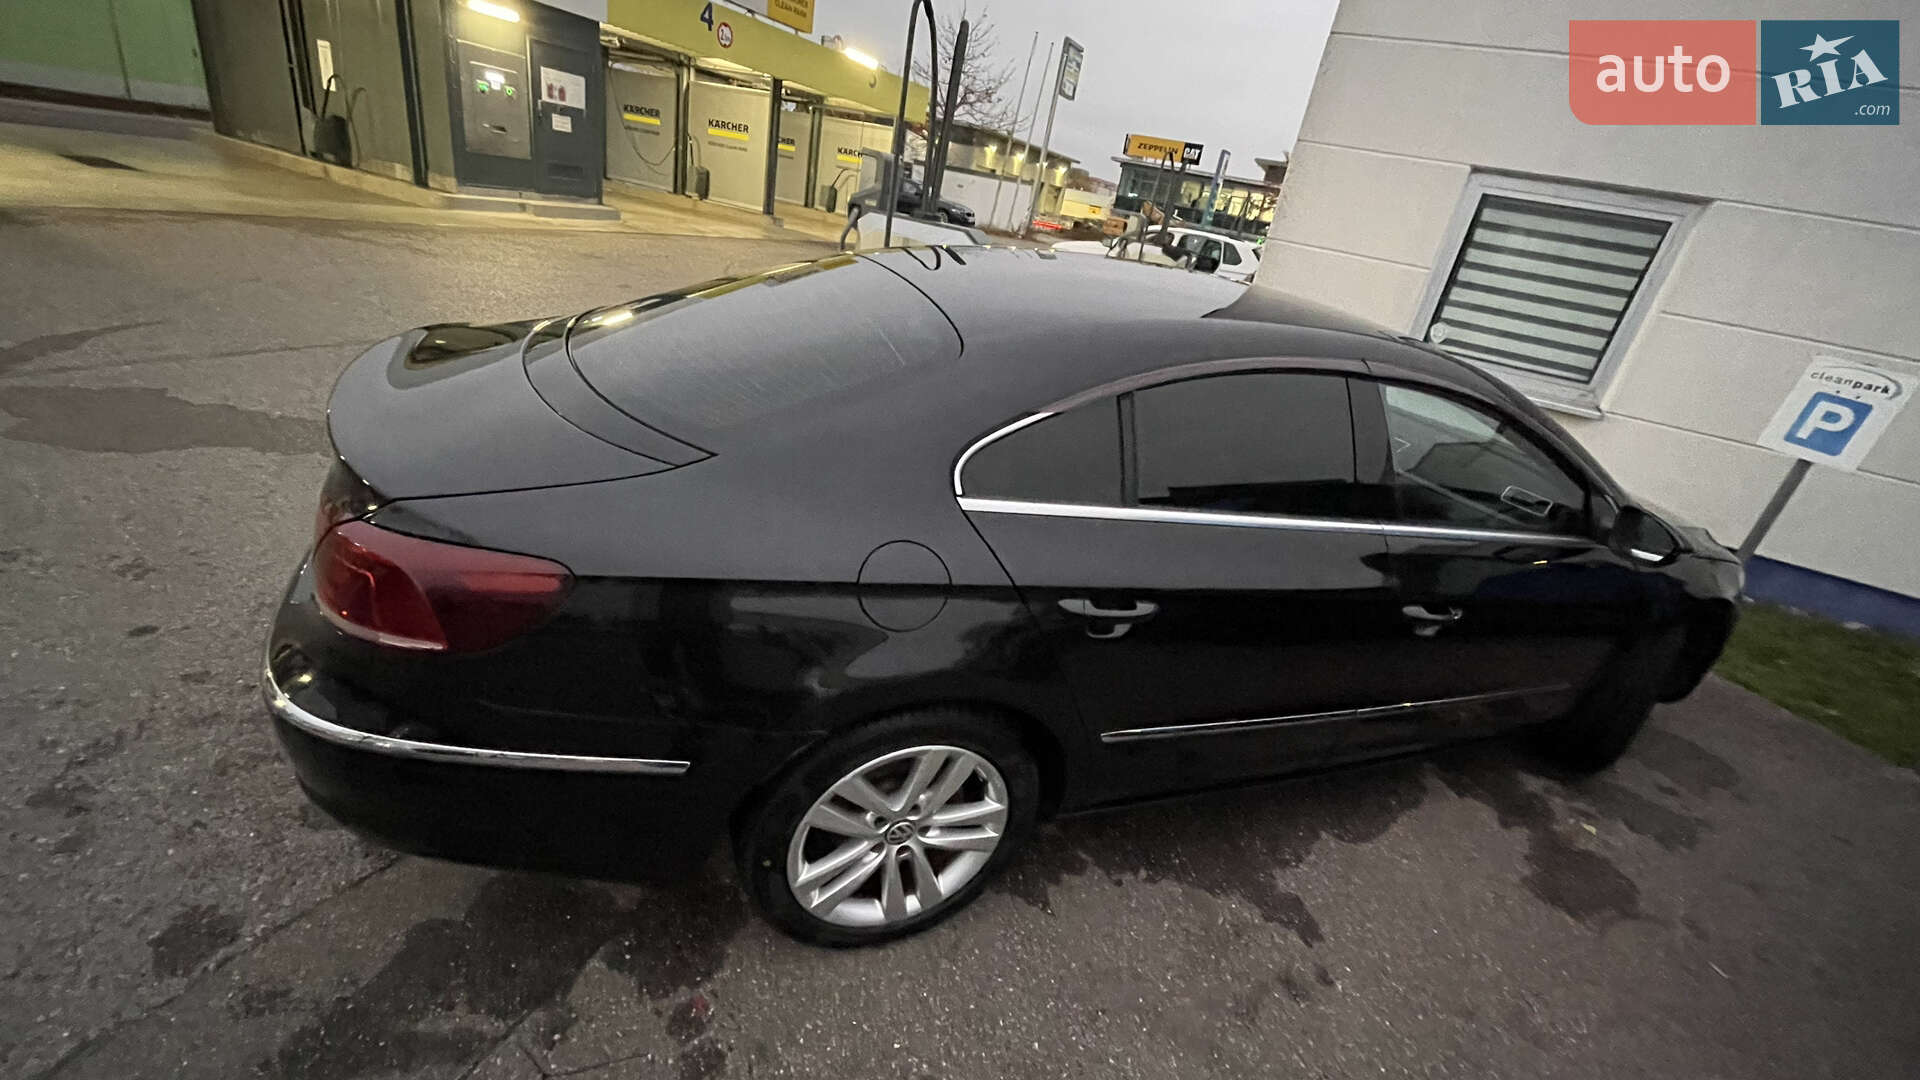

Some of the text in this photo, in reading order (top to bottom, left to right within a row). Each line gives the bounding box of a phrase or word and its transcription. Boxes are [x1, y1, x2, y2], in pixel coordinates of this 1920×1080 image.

[700, 2, 713, 31] 4
[1137, 142, 1201, 160] ZEPPELIN CAT
[1810, 371, 1891, 395] cleanpark
[1796, 401, 1855, 440] P
